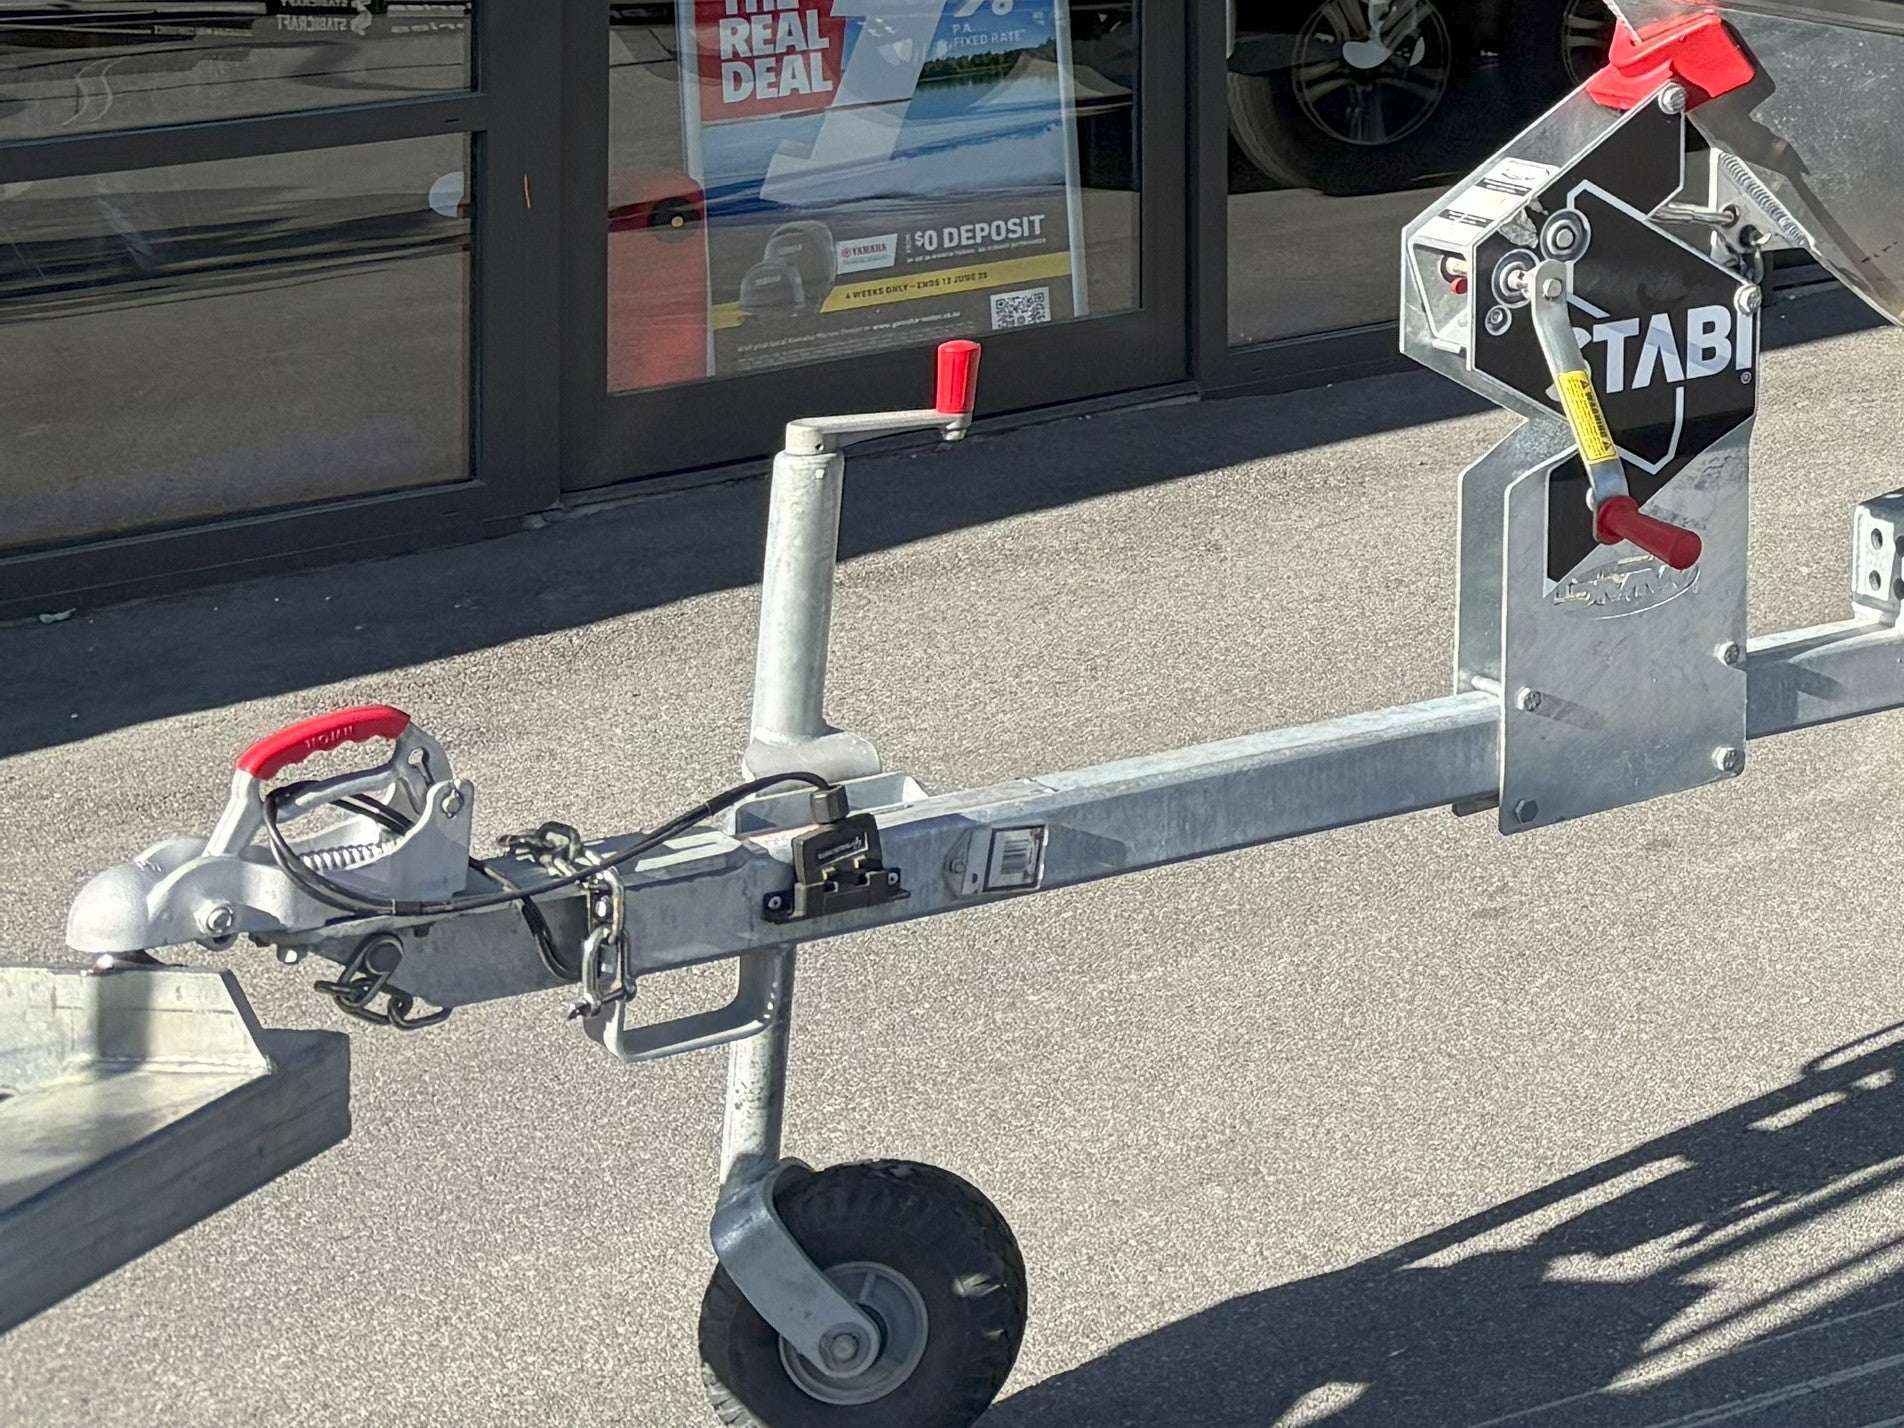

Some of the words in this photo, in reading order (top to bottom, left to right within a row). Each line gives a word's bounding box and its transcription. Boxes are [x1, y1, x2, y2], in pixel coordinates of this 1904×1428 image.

[719, 9, 830, 60] REAL
[721, 52, 833, 104] DEAL
[852, 244, 887, 256] YAMAHA
[915, 230, 938, 251] $0
[943, 215, 1045, 250] DEPOSIT
[1547, 307, 1754, 400] TABI
